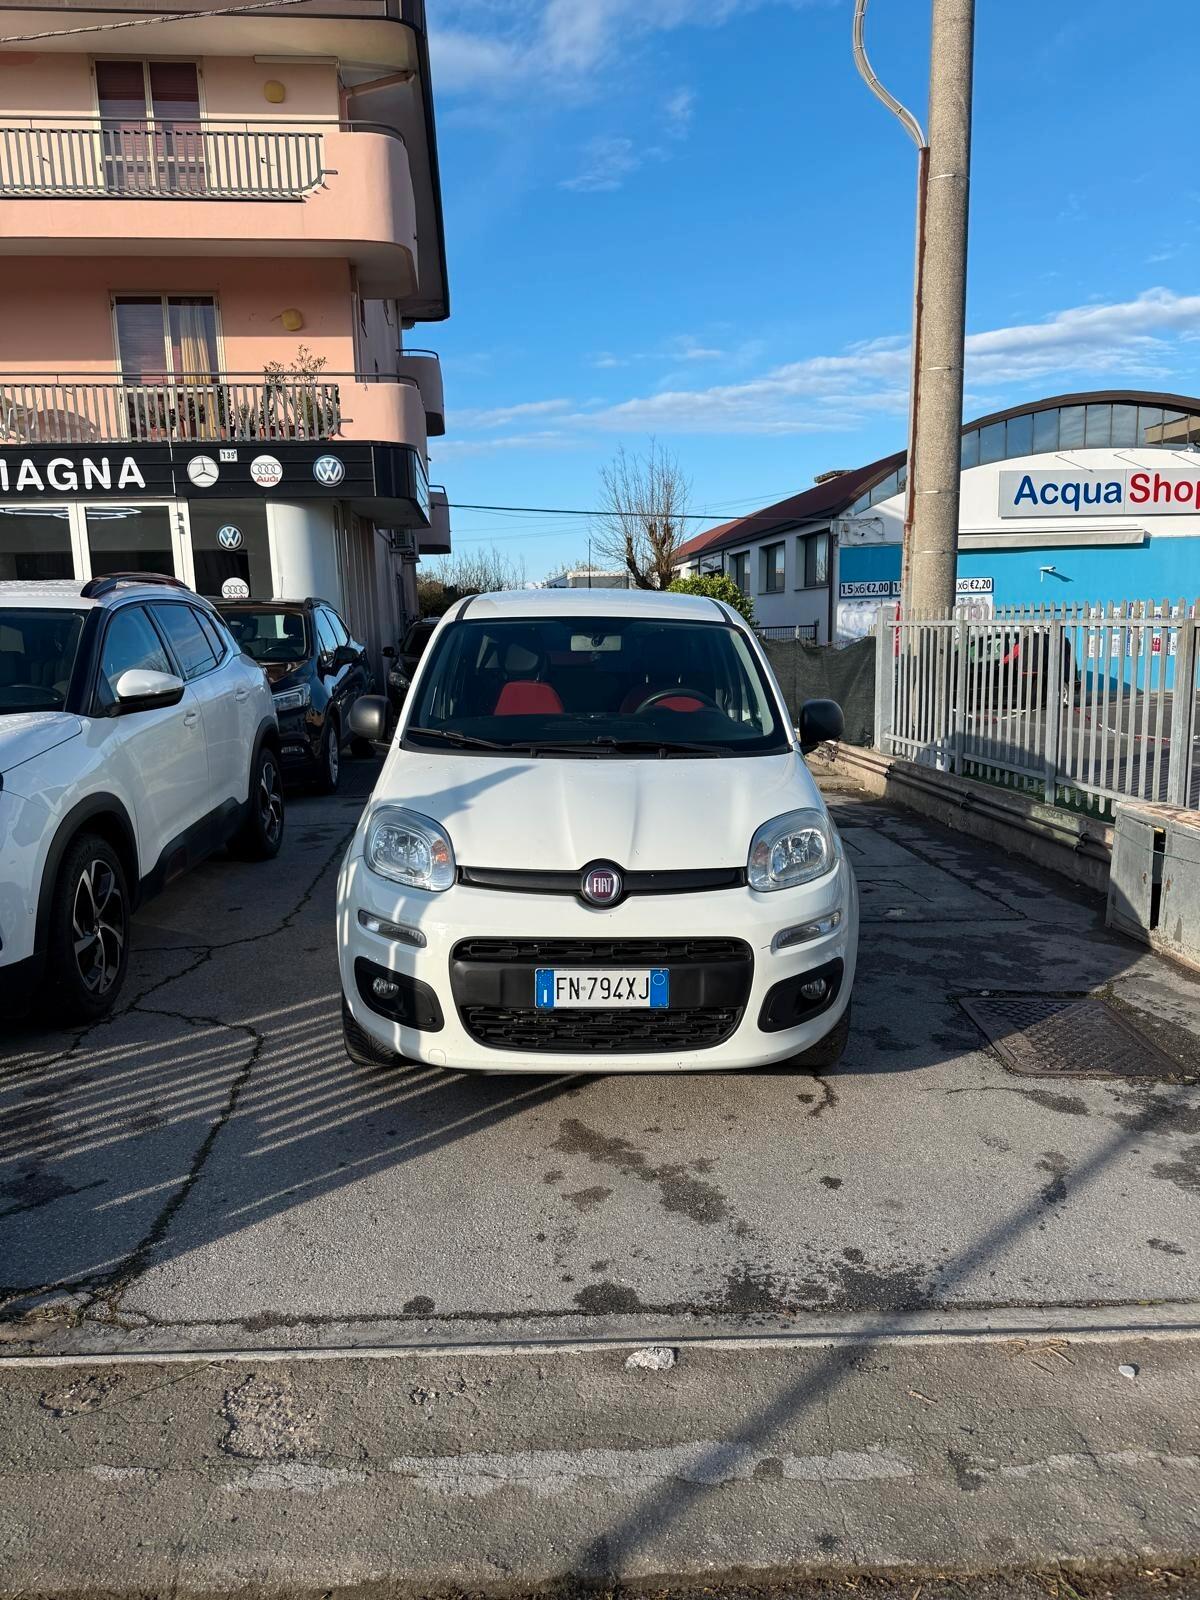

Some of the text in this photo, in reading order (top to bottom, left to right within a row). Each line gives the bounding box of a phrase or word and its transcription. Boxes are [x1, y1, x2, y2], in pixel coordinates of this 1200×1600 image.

[256, 475, 279, 483] Audi
[1014, 473, 1200, 512] Acqua Sho
[970, 579, 991, 591] €2,20
[593, 877, 613, 893] FIAT
